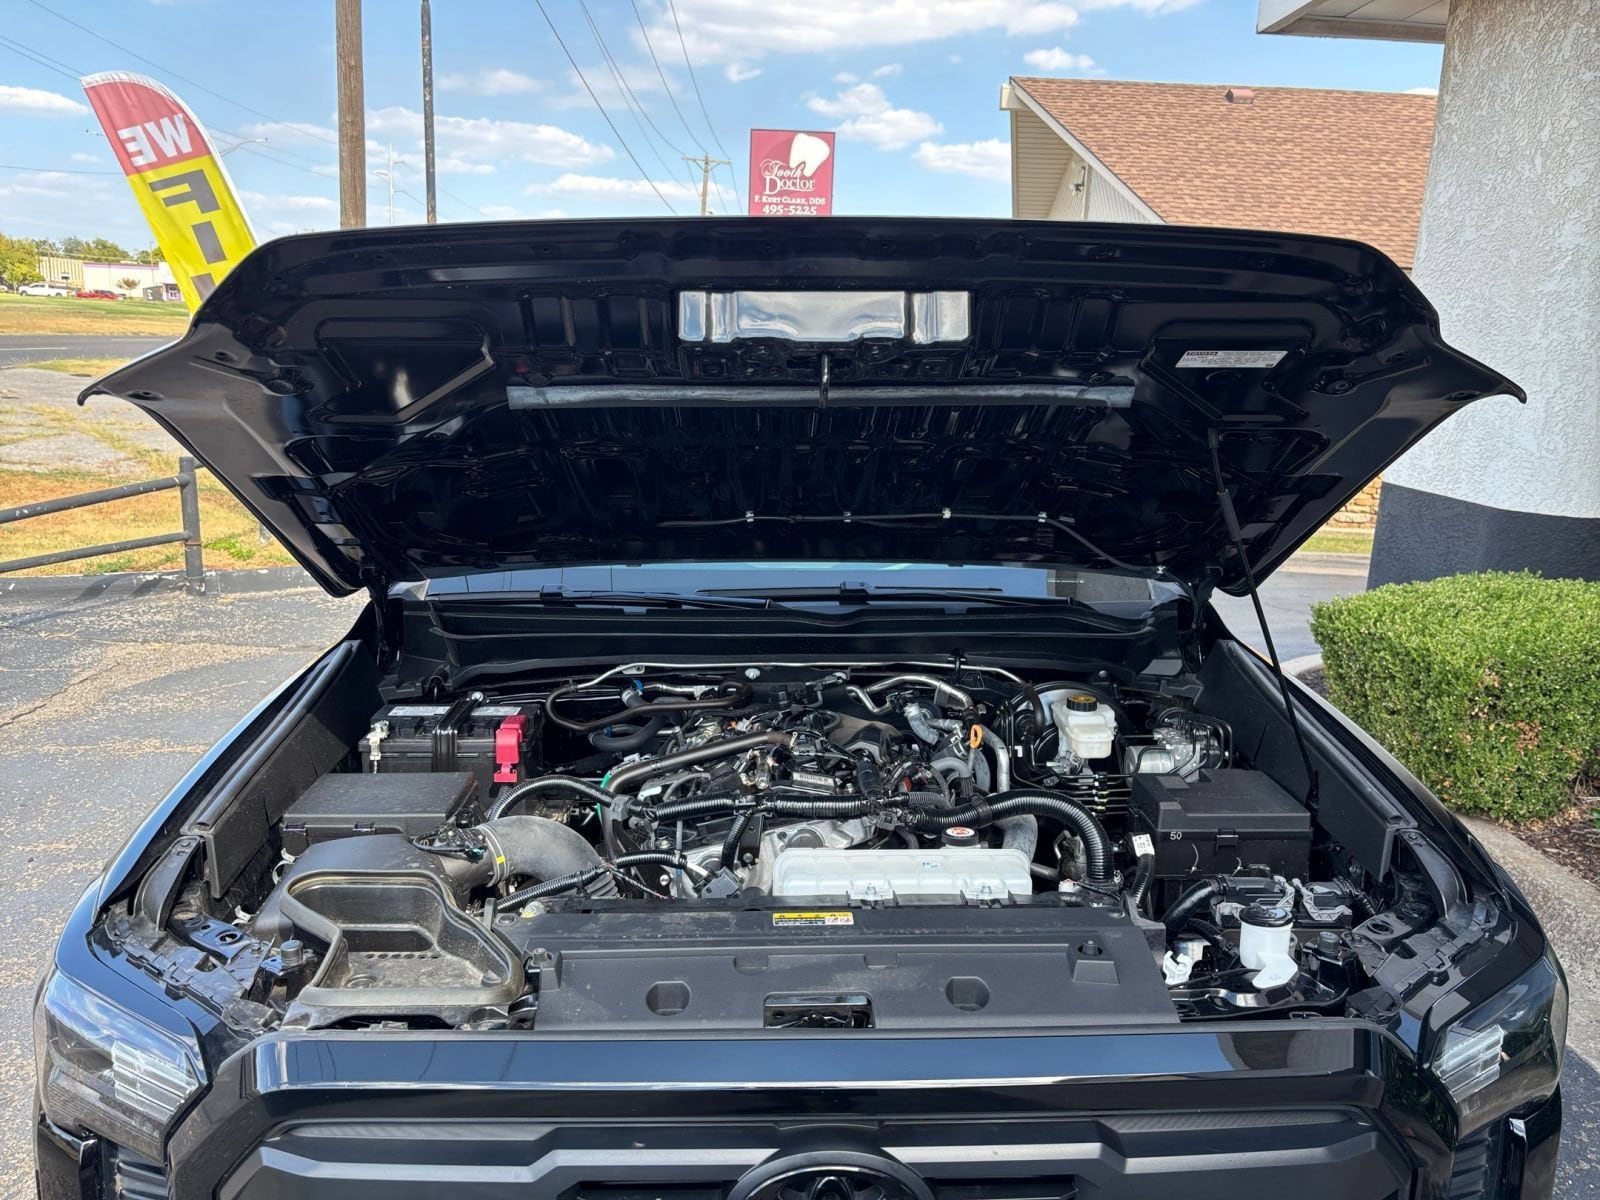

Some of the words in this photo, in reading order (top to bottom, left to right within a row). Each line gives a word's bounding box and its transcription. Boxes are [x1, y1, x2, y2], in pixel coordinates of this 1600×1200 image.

[764, 175, 815, 195] Doctor
[762, 204, 817, 216] 495-5225
[1170, 831, 1182, 840] 50
